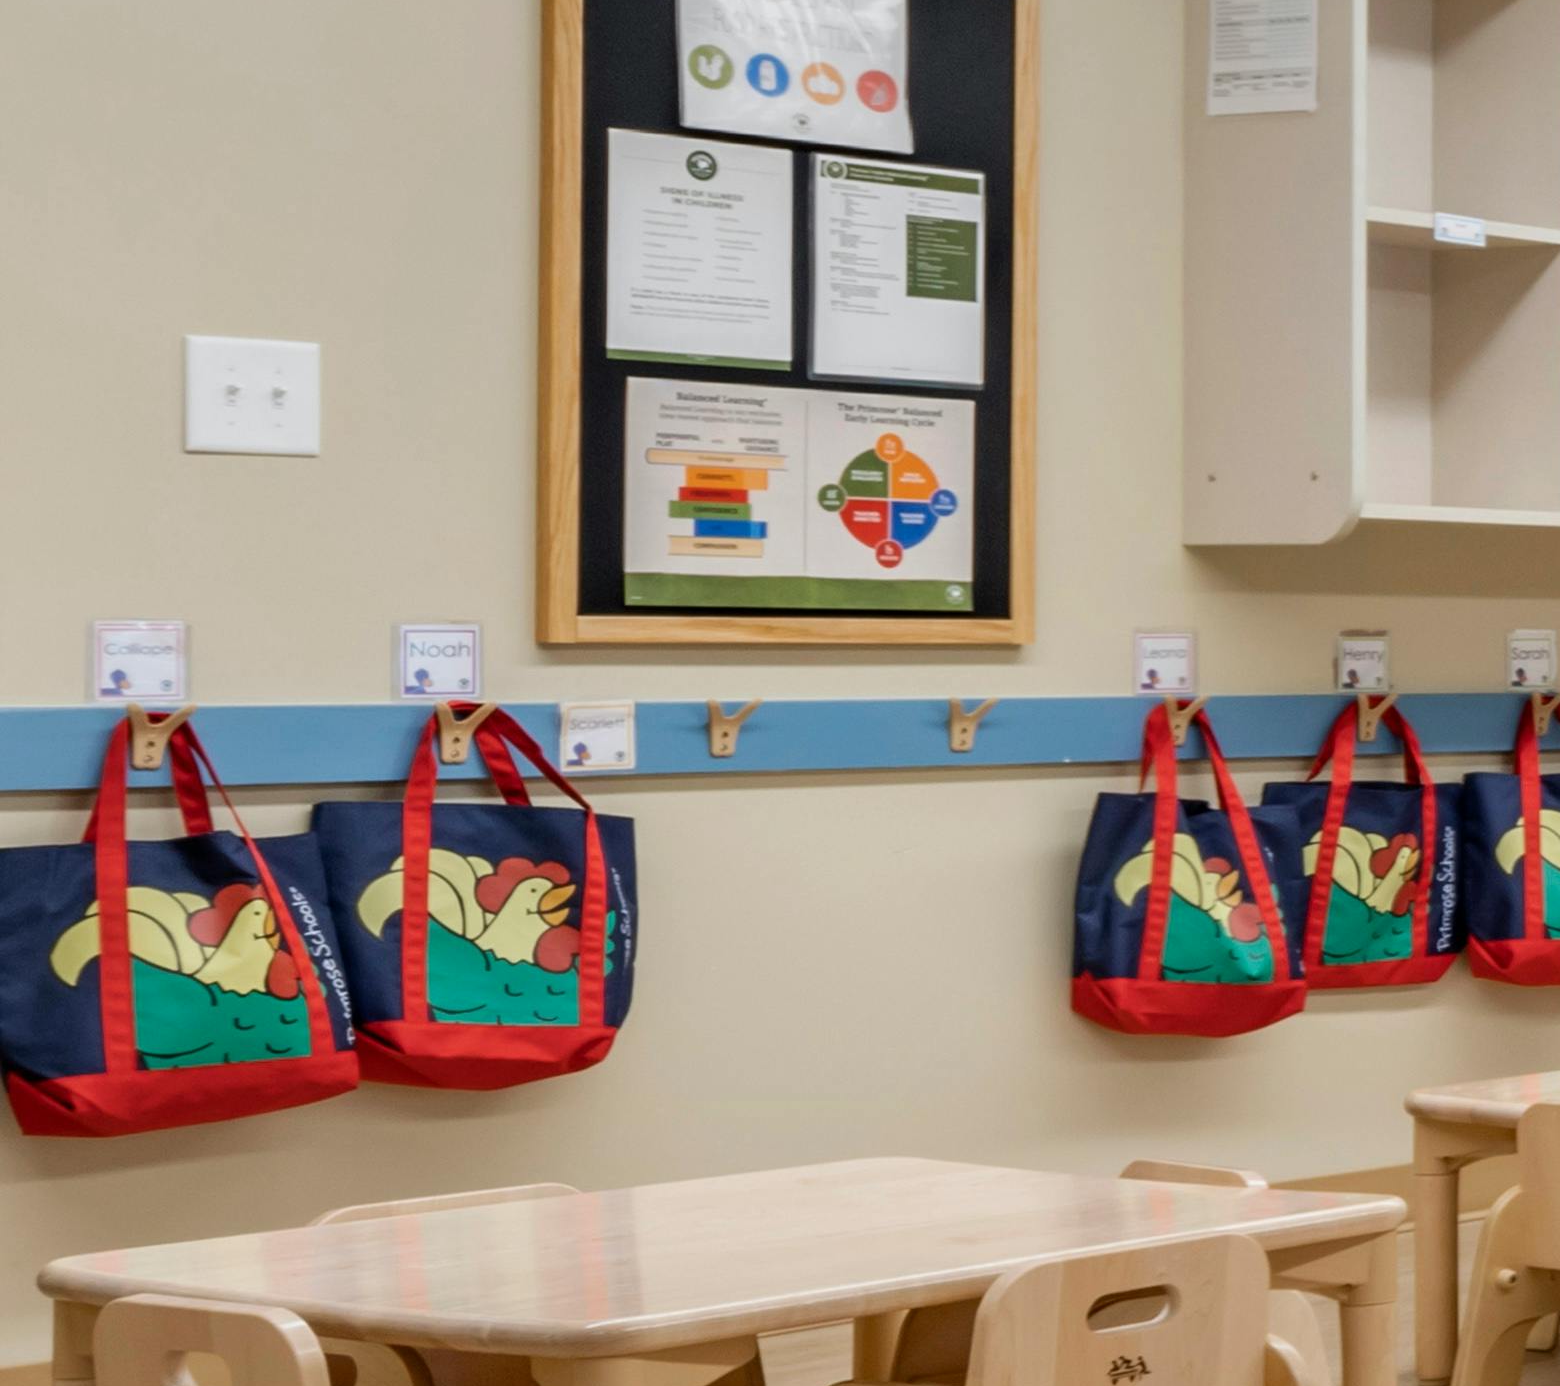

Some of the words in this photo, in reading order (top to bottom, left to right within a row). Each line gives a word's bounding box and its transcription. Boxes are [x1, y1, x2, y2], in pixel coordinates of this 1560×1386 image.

[837, 402, 855, 412] The
[903, 407, 943, 417] Balanced
[870, 416, 909, 427] Learning
[104, 642, 175, 658] Calliope
[409, 641, 471, 659] Noah
[1343, 648, 1384, 663] Henry
[1512, 647, 1550, 661] Sarah
[569, 717, 626, 731] Scarlett
[1436, 884, 1456, 952] Primrose
